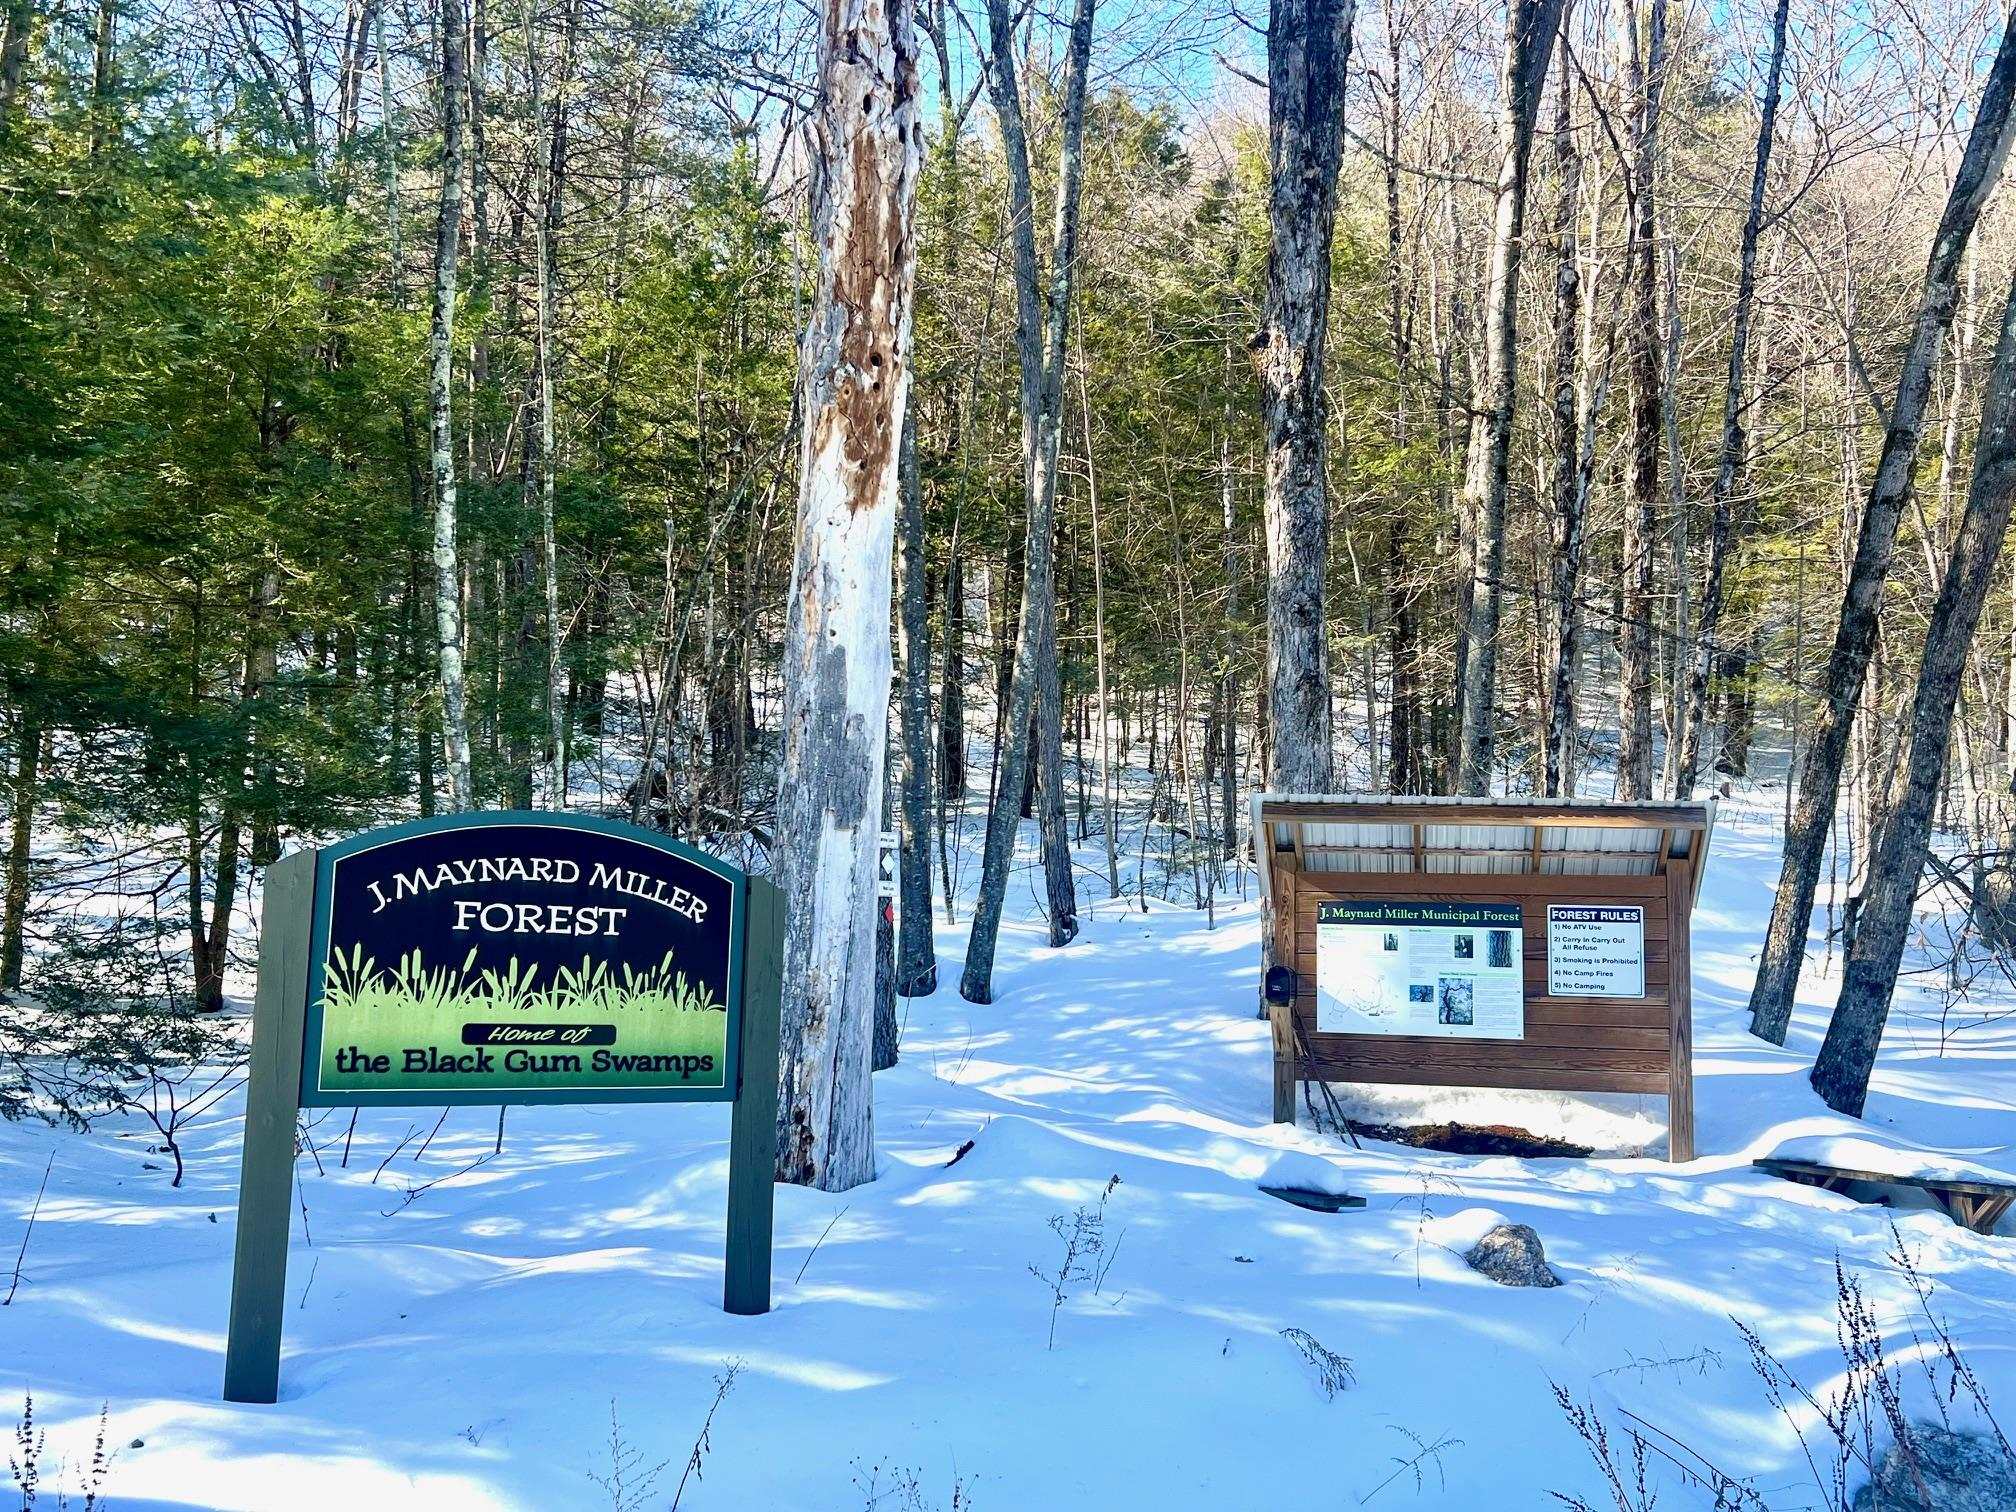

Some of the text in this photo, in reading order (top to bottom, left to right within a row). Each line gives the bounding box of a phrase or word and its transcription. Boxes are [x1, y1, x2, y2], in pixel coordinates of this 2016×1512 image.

[367, 857, 709, 924] J. MAYNARD MILLER
[452, 901, 627, 936] FOREST
[1319, 907, 1520, 923] J. Maynard Miller Municipal Forest
[1552, 910, 1639, 921] FOREST RULES
[488, 1026, 591, 1042] Home of
[334, 1047, 714, 1080] the Black Gum Swamps
